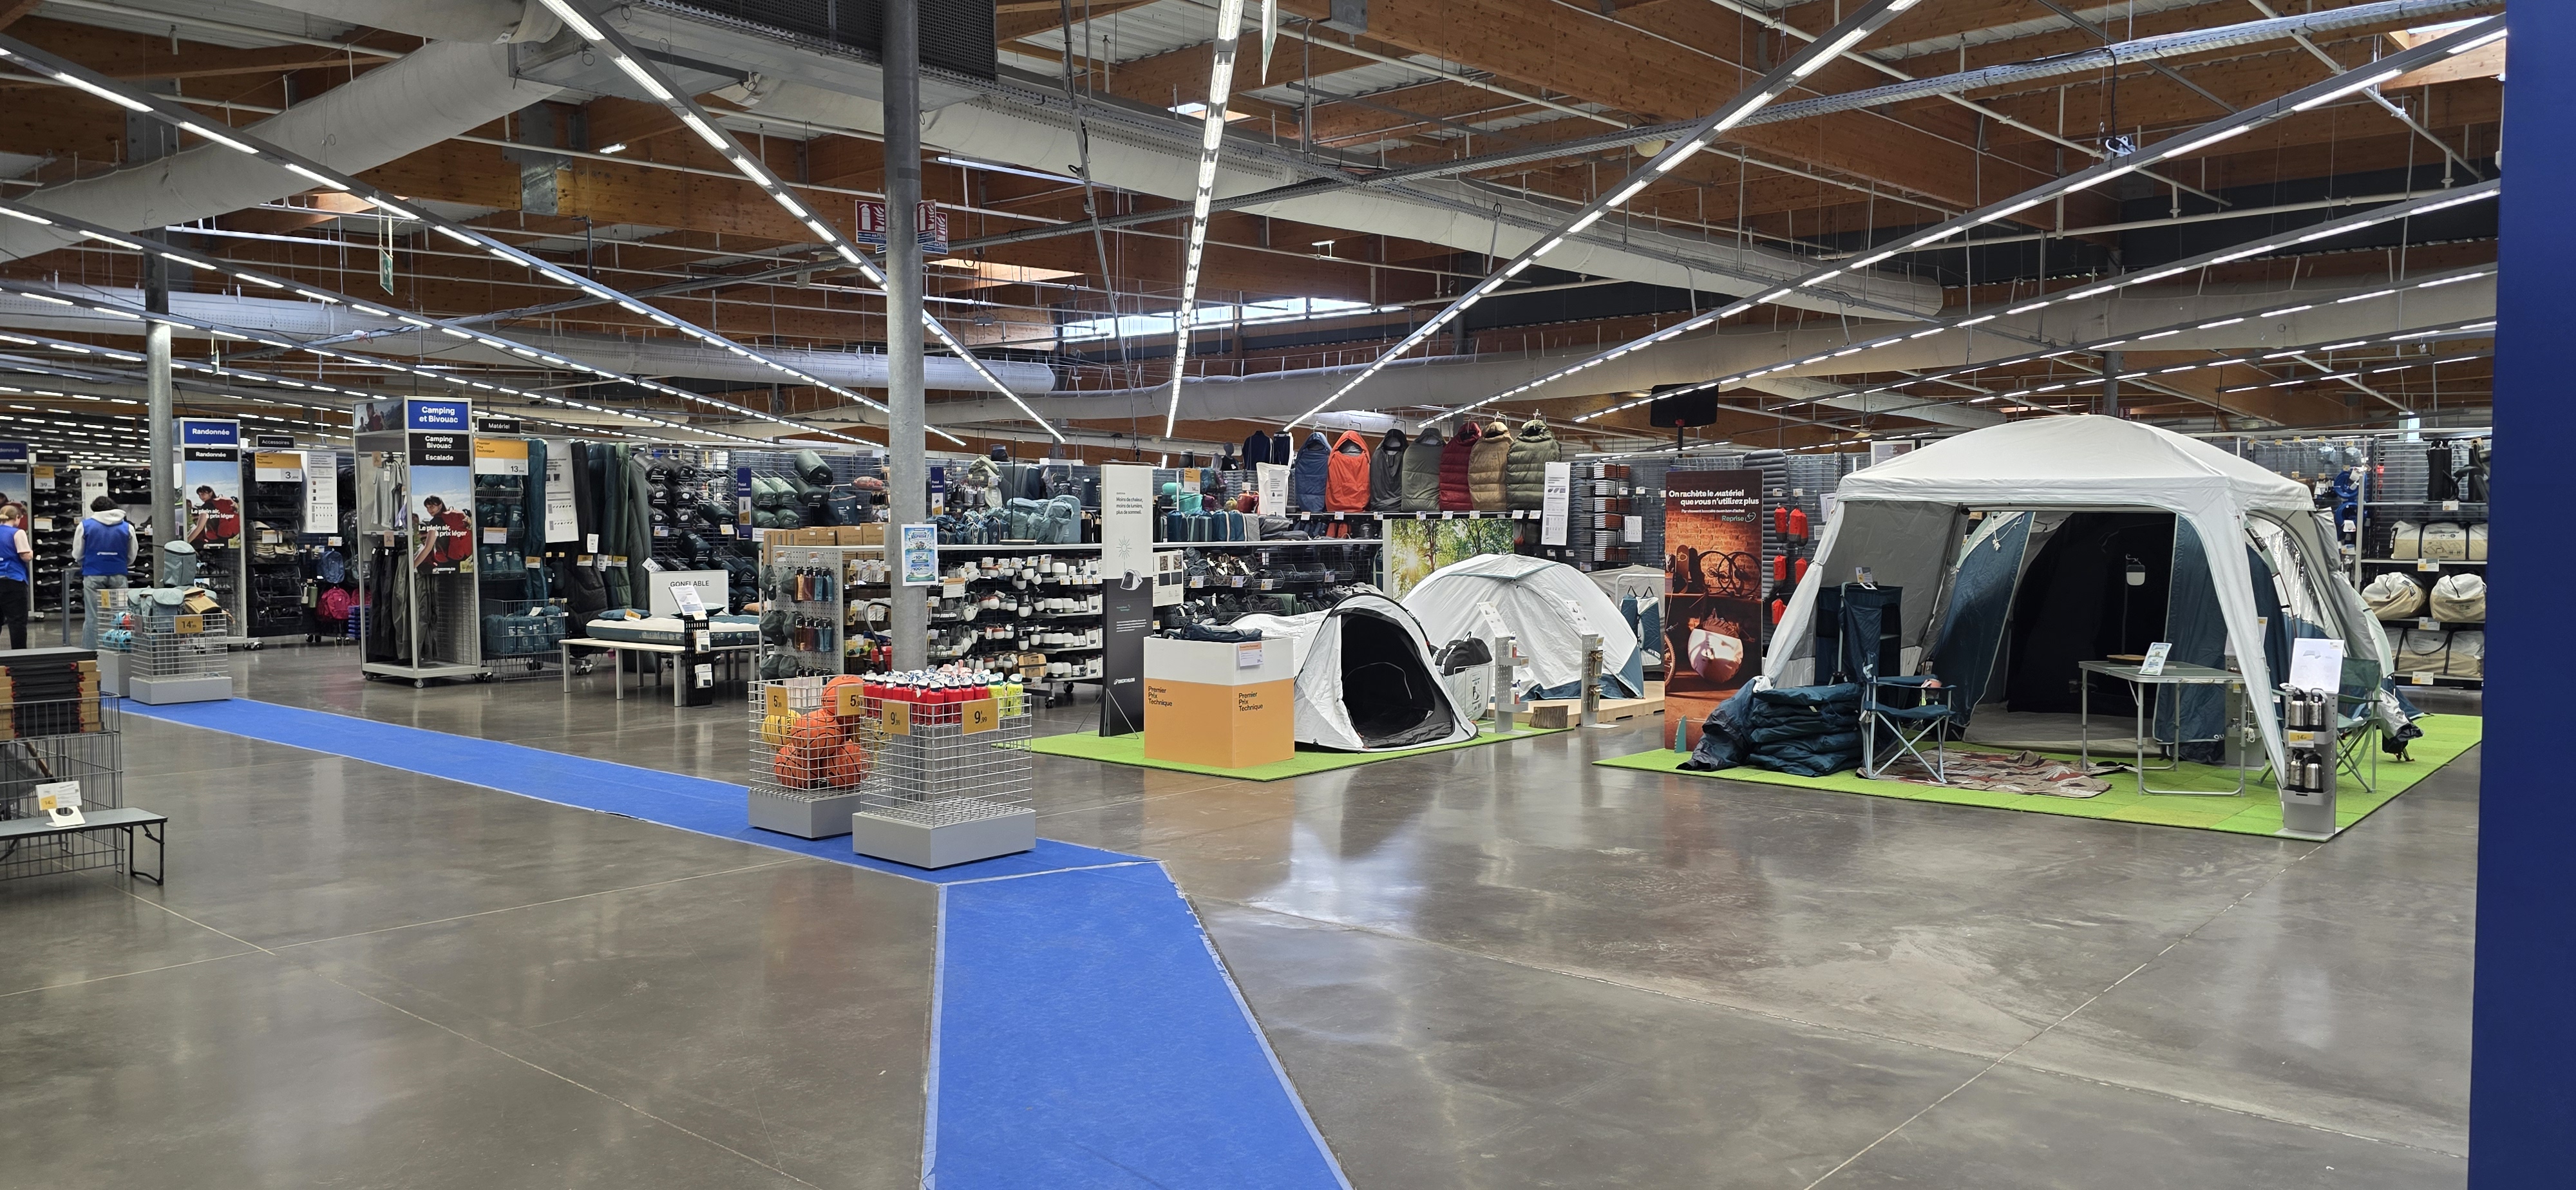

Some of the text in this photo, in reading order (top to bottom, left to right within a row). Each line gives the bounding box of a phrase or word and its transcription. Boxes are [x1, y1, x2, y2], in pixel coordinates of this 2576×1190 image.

[422, 406, 455, 415] Camping
[1743, 497, 1759, 506] plus
[1148, 698, 1172, 707] Technique
